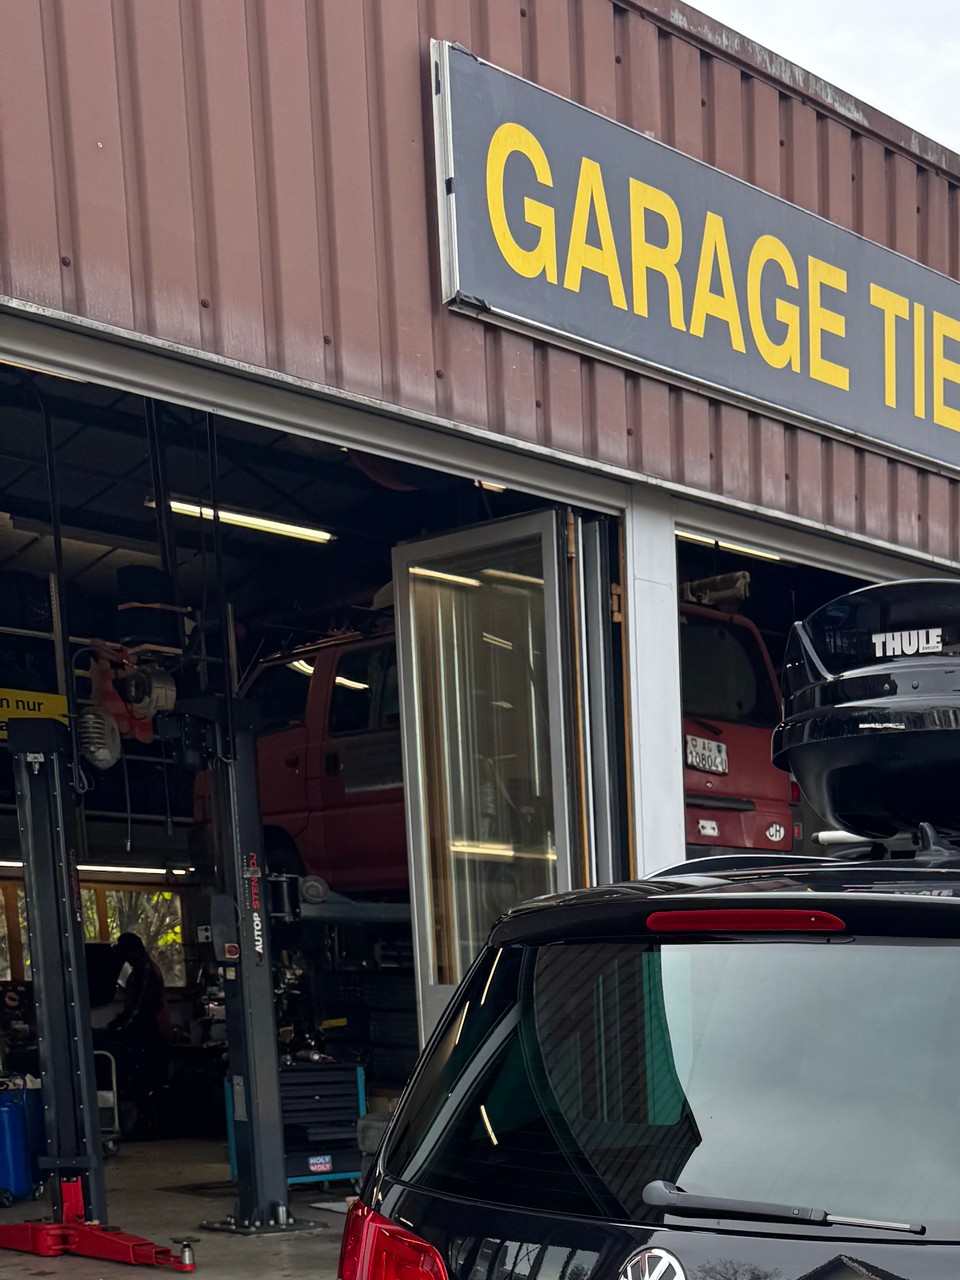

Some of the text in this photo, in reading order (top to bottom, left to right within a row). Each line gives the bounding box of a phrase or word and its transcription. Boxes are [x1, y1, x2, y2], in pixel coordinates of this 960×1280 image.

[486, 123, 850, 391] GARAGE
[871, 627, 943, 658] THULE
[16, 699, 43, 712] nur
[768, 823, 782, 839] CH
[253, 911, 264, 954] AUTOP
